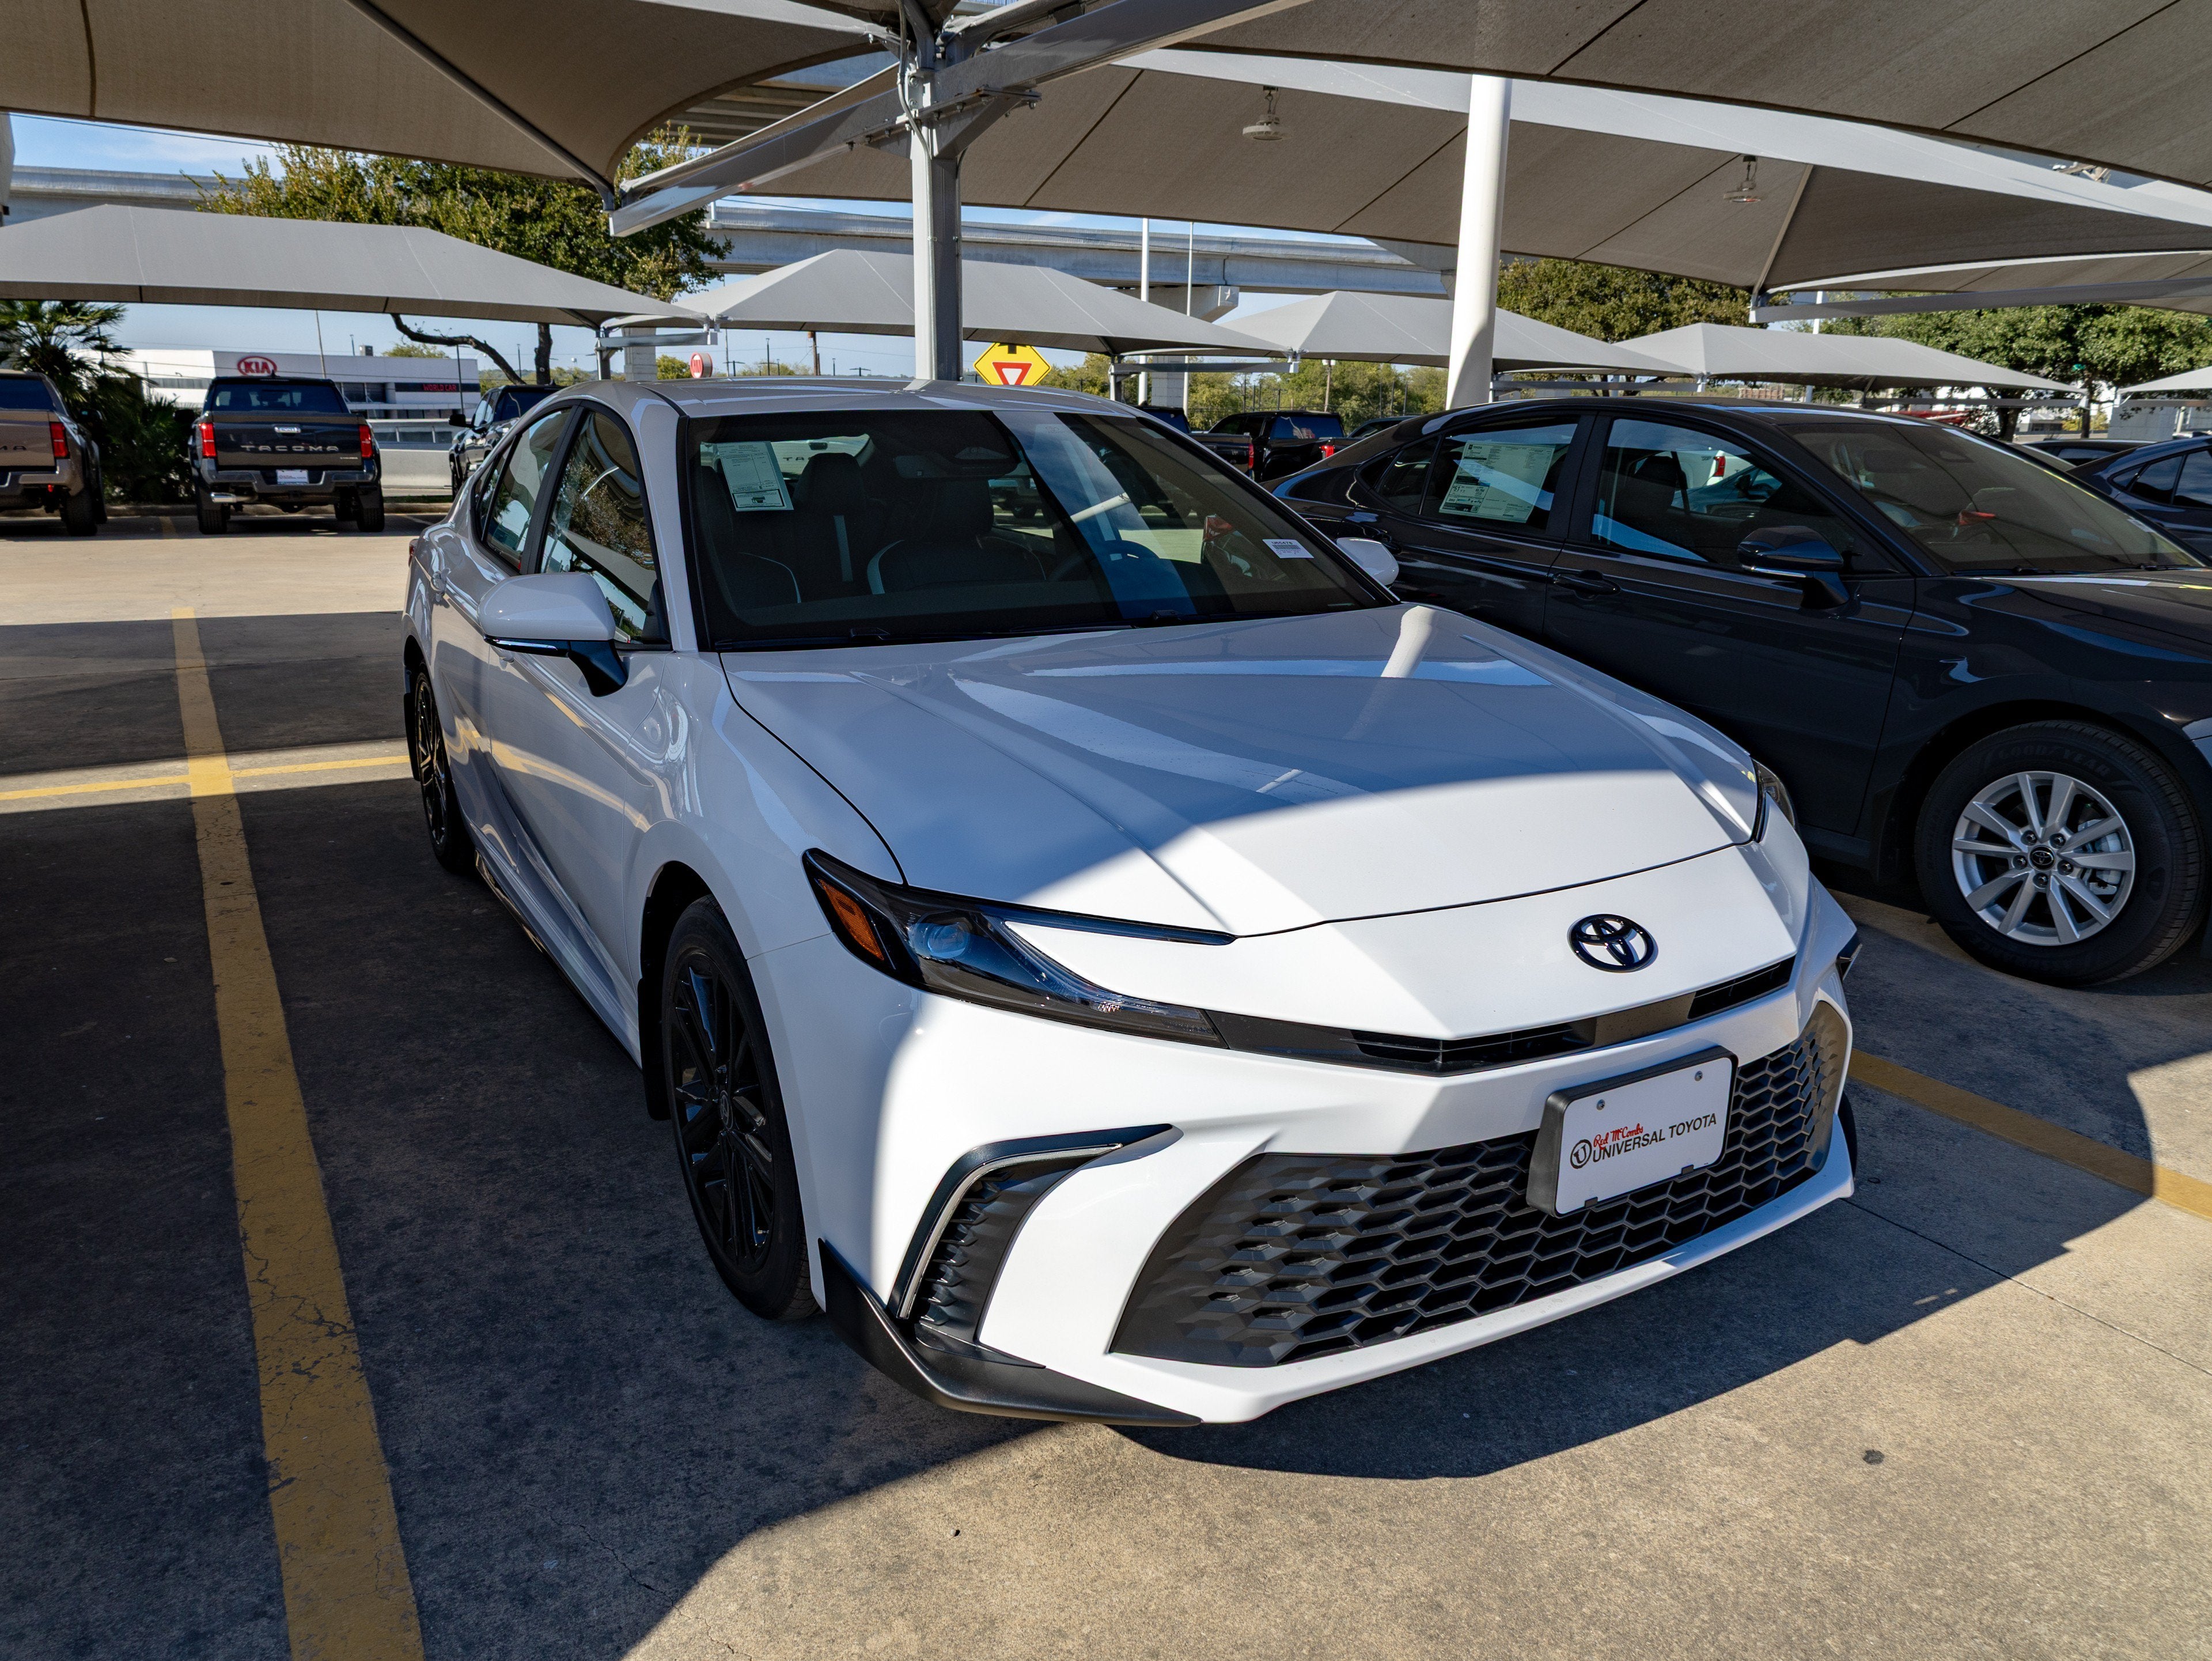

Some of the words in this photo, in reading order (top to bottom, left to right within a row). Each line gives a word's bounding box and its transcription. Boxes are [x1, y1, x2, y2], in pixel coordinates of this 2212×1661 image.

[244, 361, 271, 374] KIA
[1592, 1129, 1665, 1163] UNIVERSAL
[1668, 1113, 1717, 1138] TOYOTA
[1593, 1133, 1609, 1151] Red
